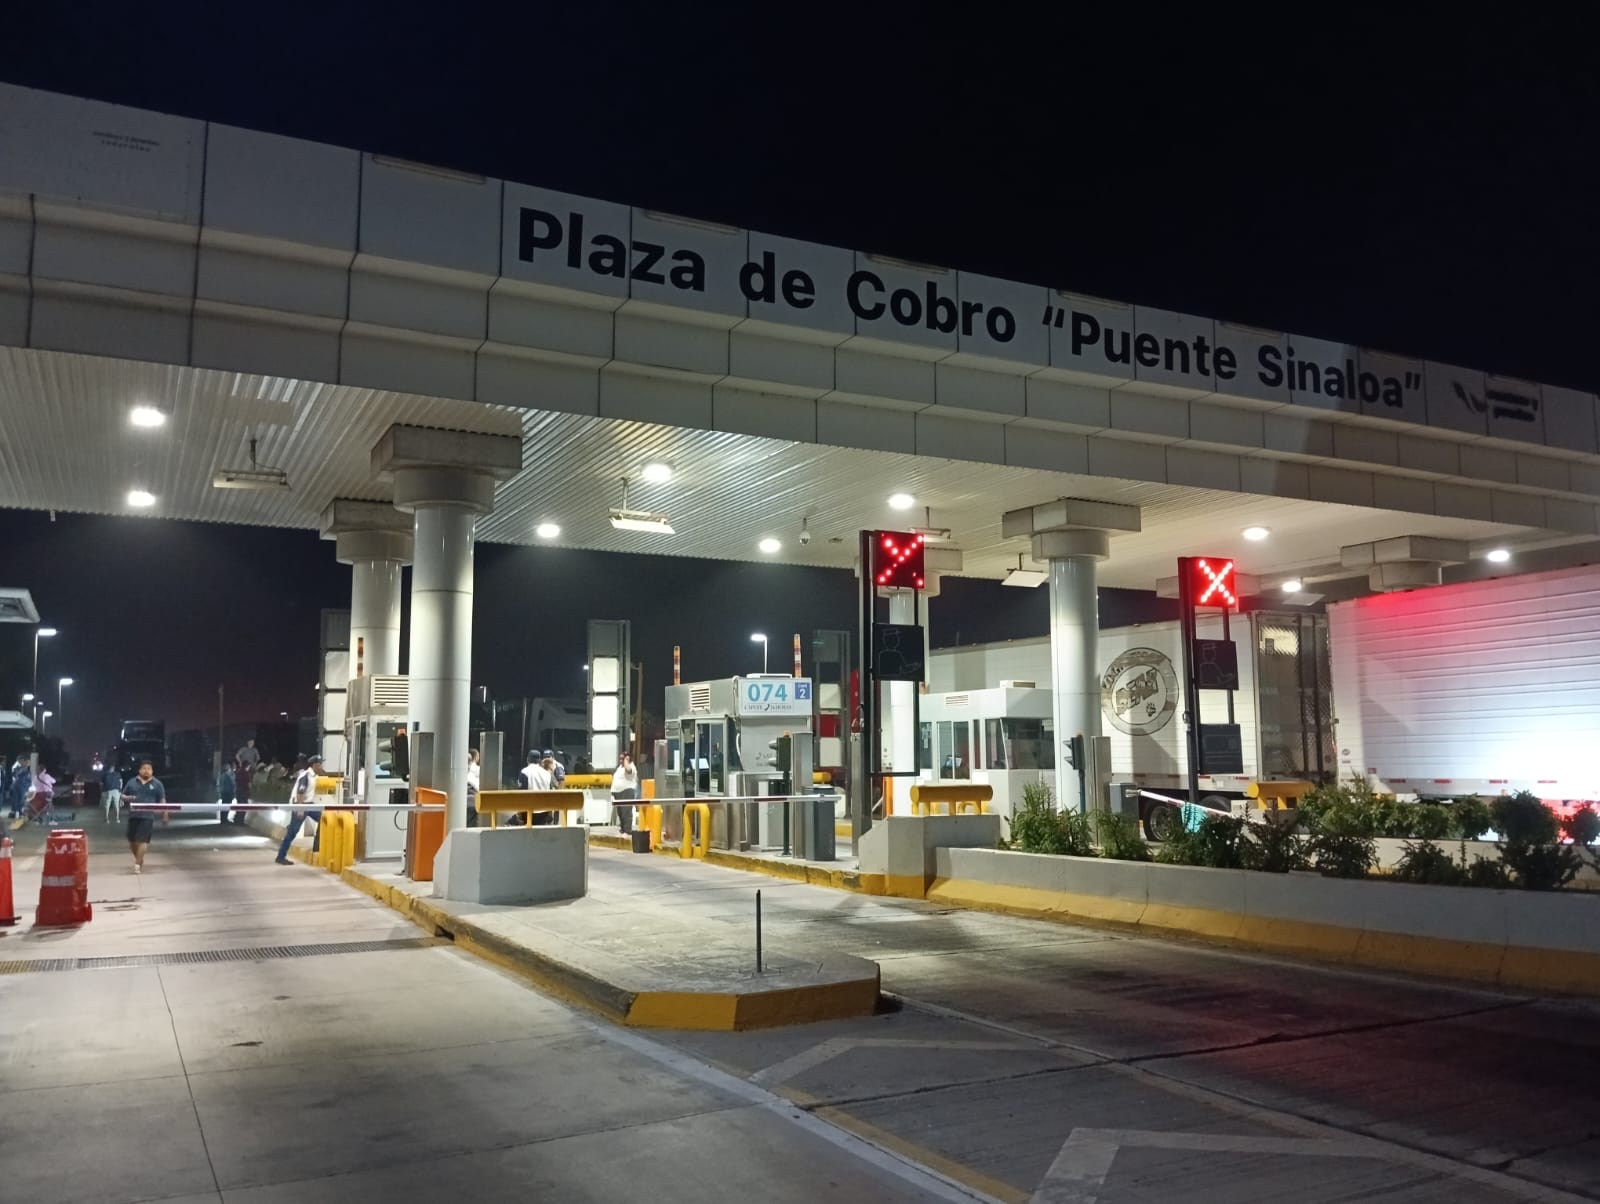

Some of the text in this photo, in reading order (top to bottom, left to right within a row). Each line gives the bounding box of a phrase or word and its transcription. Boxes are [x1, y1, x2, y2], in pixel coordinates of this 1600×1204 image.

[519, 207, 705, 292] Plaza
[739, 251, 815, 309] de
[846, 270, 1016, 343] Cobro
[748, 683, 787, 702] 074
[799, 688, 806, 699] 2
